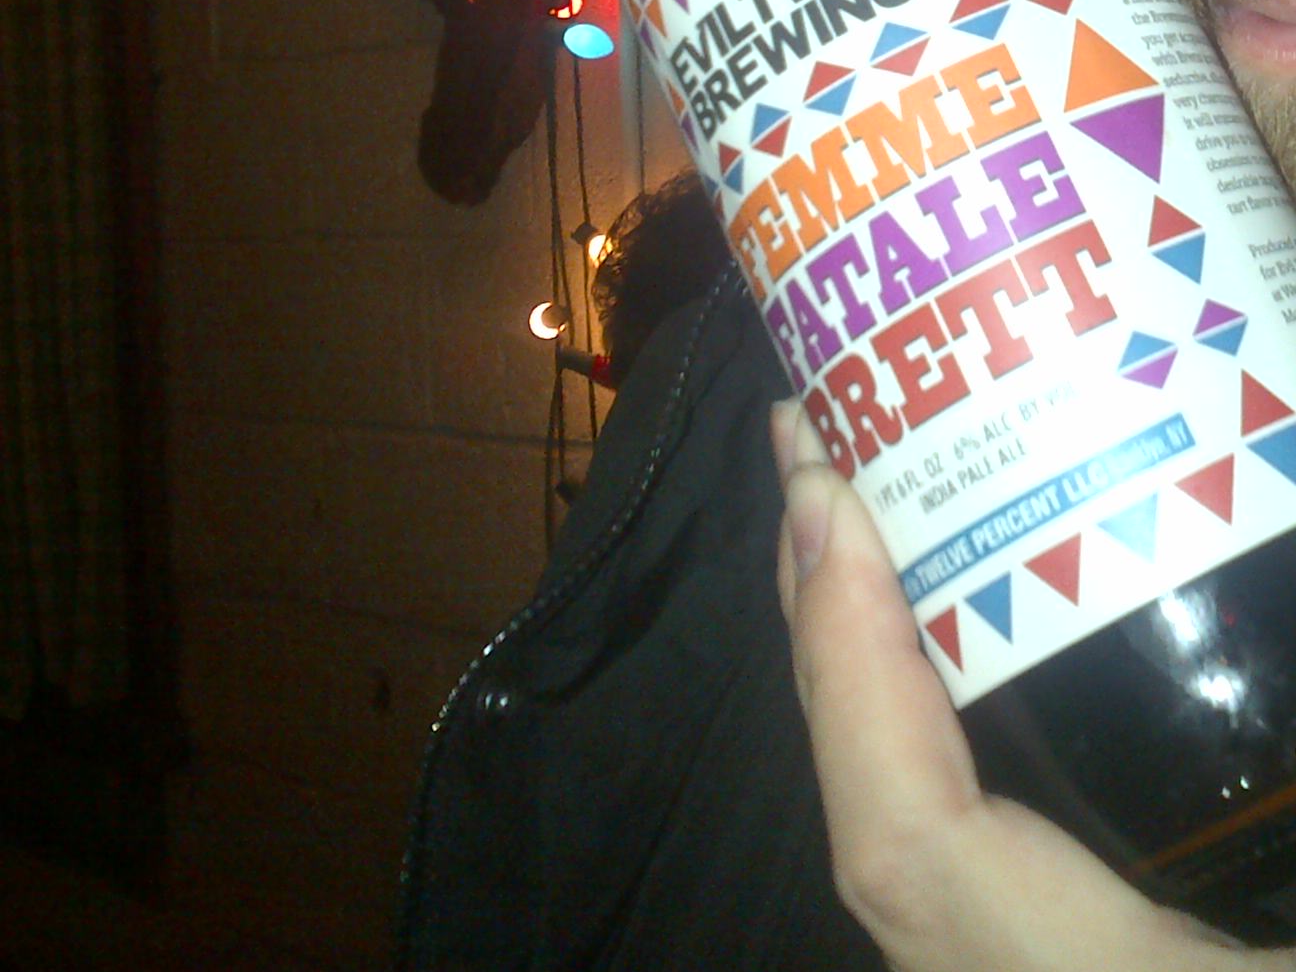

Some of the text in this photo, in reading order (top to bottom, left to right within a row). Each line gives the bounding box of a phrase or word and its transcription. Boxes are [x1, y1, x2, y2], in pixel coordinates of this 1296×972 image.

[670, 1, 757, 94] EVIL
[728, 43, 1042, 300] FEMME
[765, 130, 1086, 393] FATALE
[803, 219, 1118, 481] BRETT
[915, 537, 974, 590] TWELVE
[972, 483, 1063, 554] PERCENT
